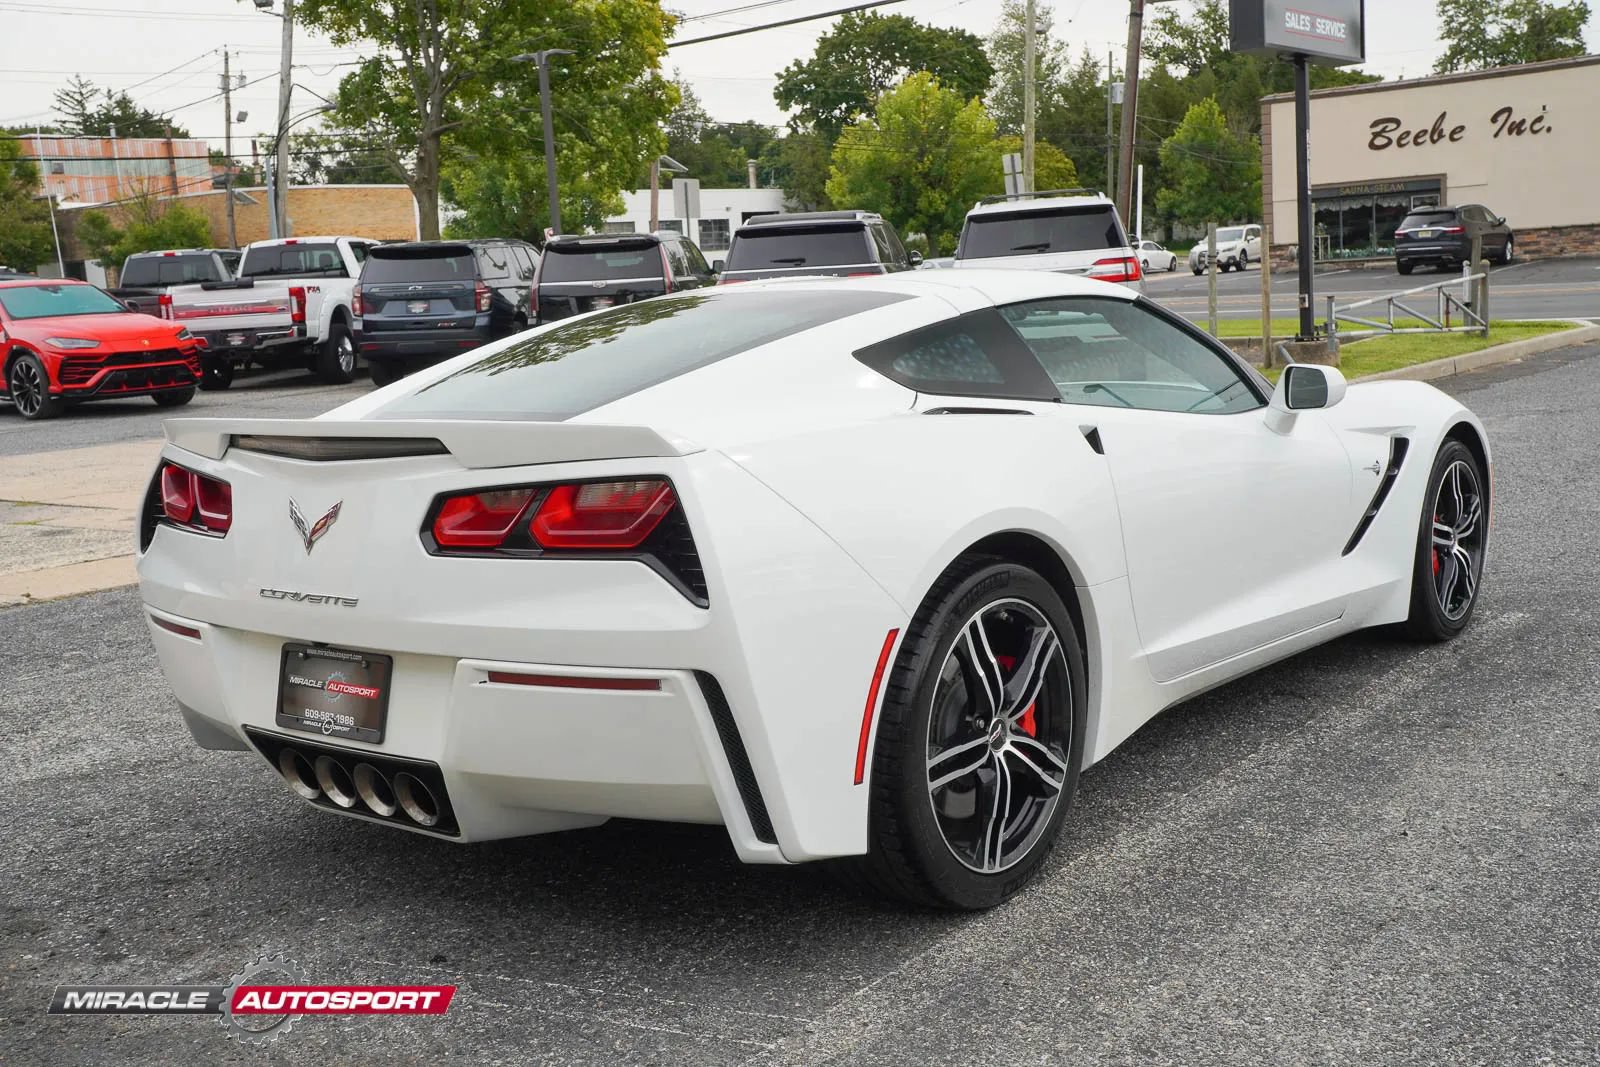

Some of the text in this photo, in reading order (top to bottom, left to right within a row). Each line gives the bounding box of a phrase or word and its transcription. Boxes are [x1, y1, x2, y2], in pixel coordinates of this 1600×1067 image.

[1285, 12, 1346, 39] SALES SERVICE
[1368, 106, 1553, 151] Beebe Inc.
[260, 588, 359, 607] CORVETTE
[289, 676, 376, 697] MIRACLE AUTOSPORT
